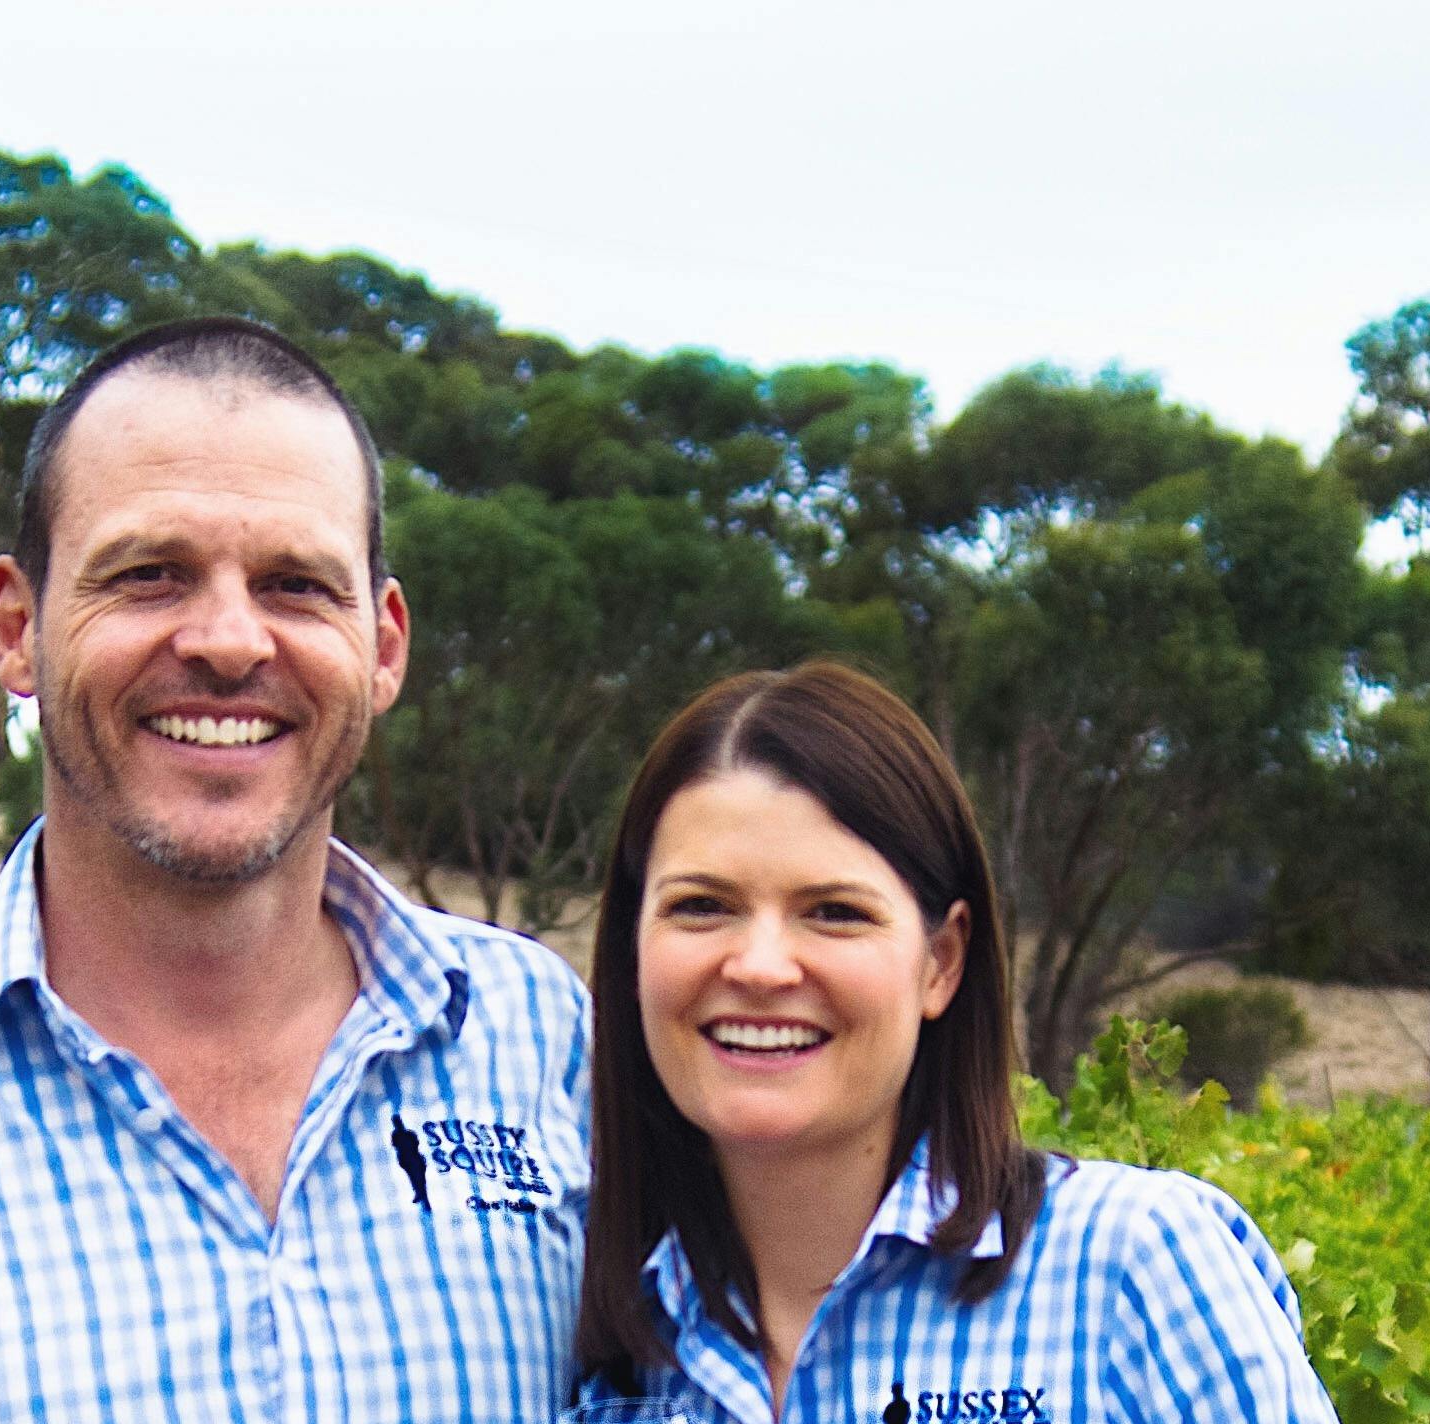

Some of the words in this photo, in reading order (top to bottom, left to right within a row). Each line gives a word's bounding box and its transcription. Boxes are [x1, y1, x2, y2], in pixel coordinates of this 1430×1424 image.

[422, 1118, 526, 1150] SUSSEX
[432, 1144, 545, 1181] SQUIRE
[916, 1387, 1046, 1421] SUSSEX
